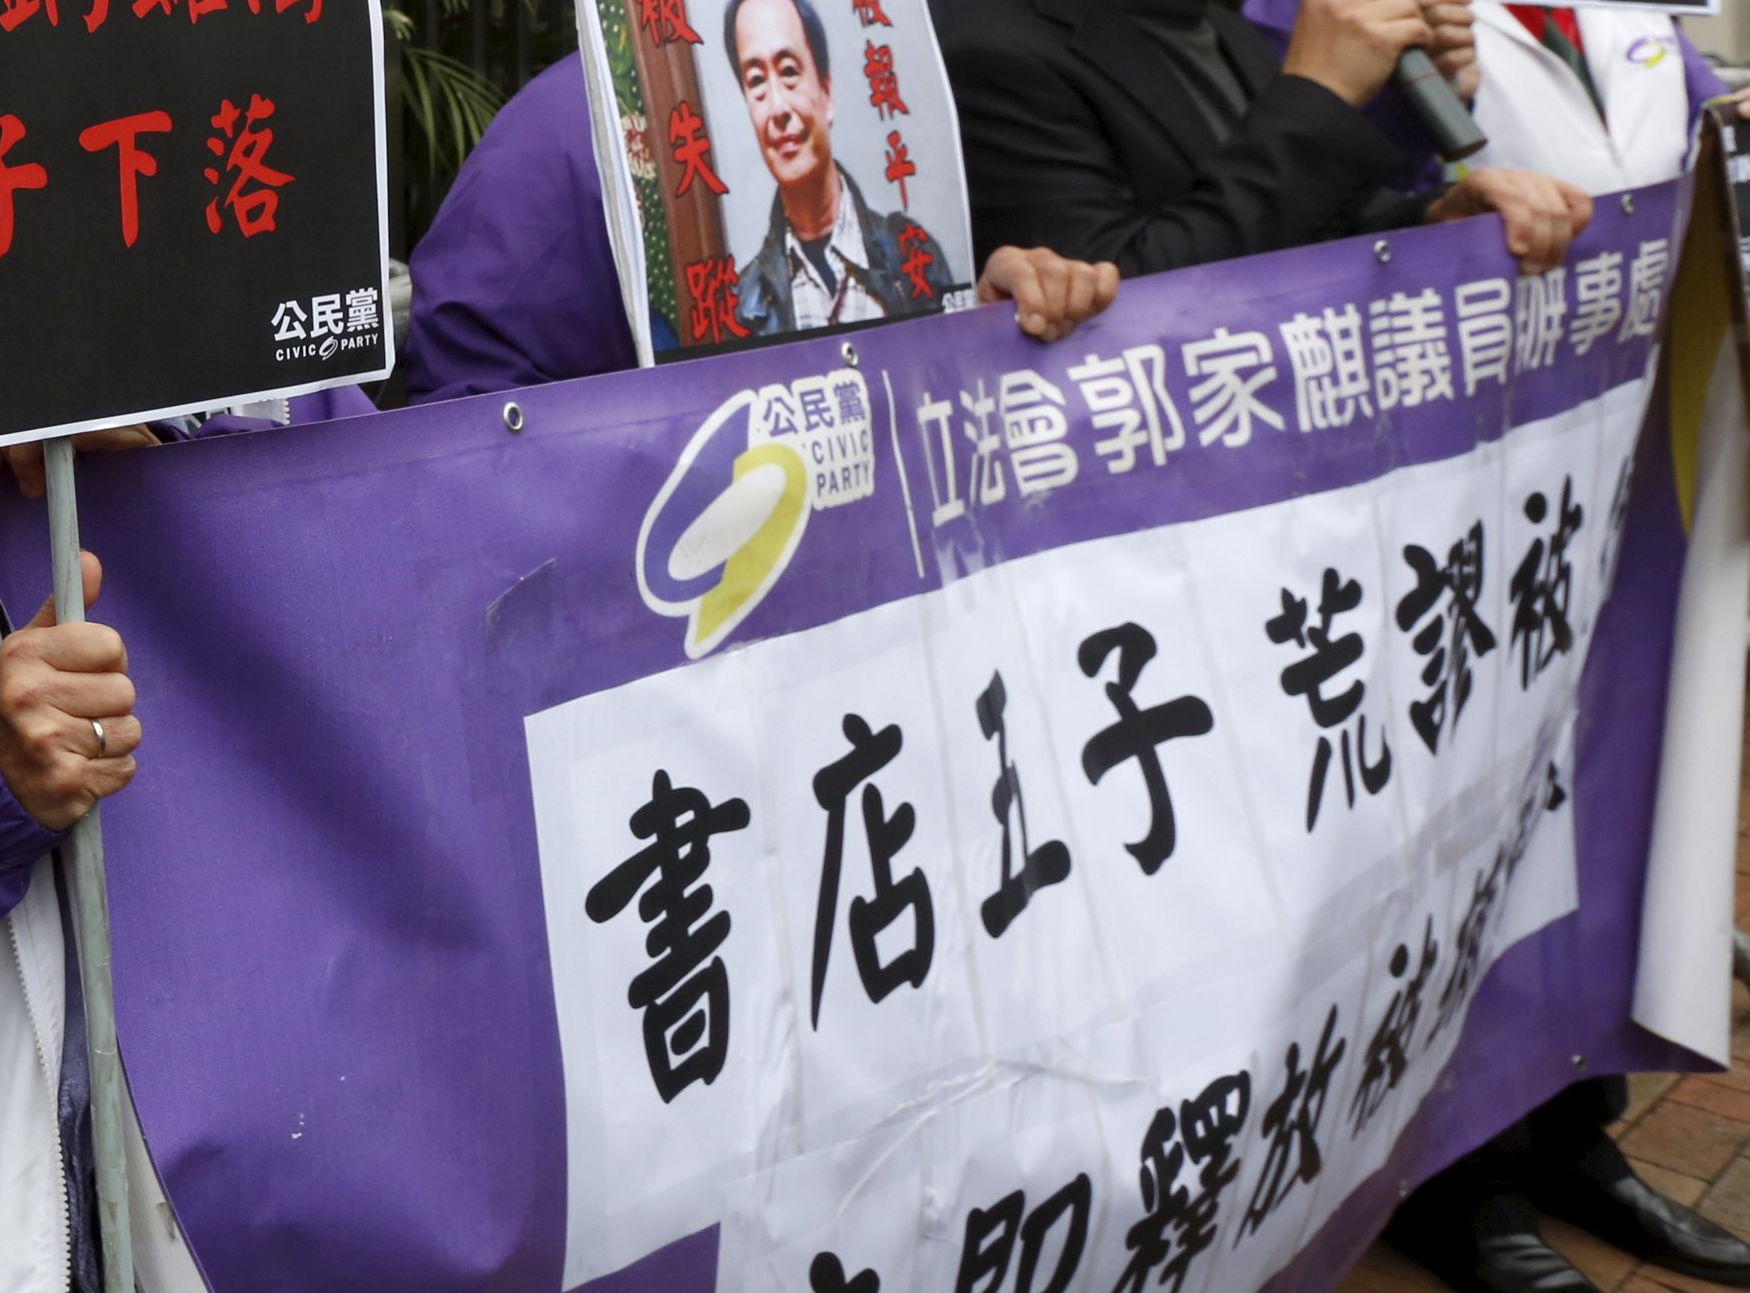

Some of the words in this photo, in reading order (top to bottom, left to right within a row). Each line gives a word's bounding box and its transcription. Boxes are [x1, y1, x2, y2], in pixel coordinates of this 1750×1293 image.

[271, 287, 379, 342] 公民黨
[275, 343, 317, 362] CIVIC
[340, 333, 379, 351] PARTY
[763, 380, 866, 437] 公民黨
[811, 428, 869, 465] CIVIC
[816, 459, 871, 498] PARTY
